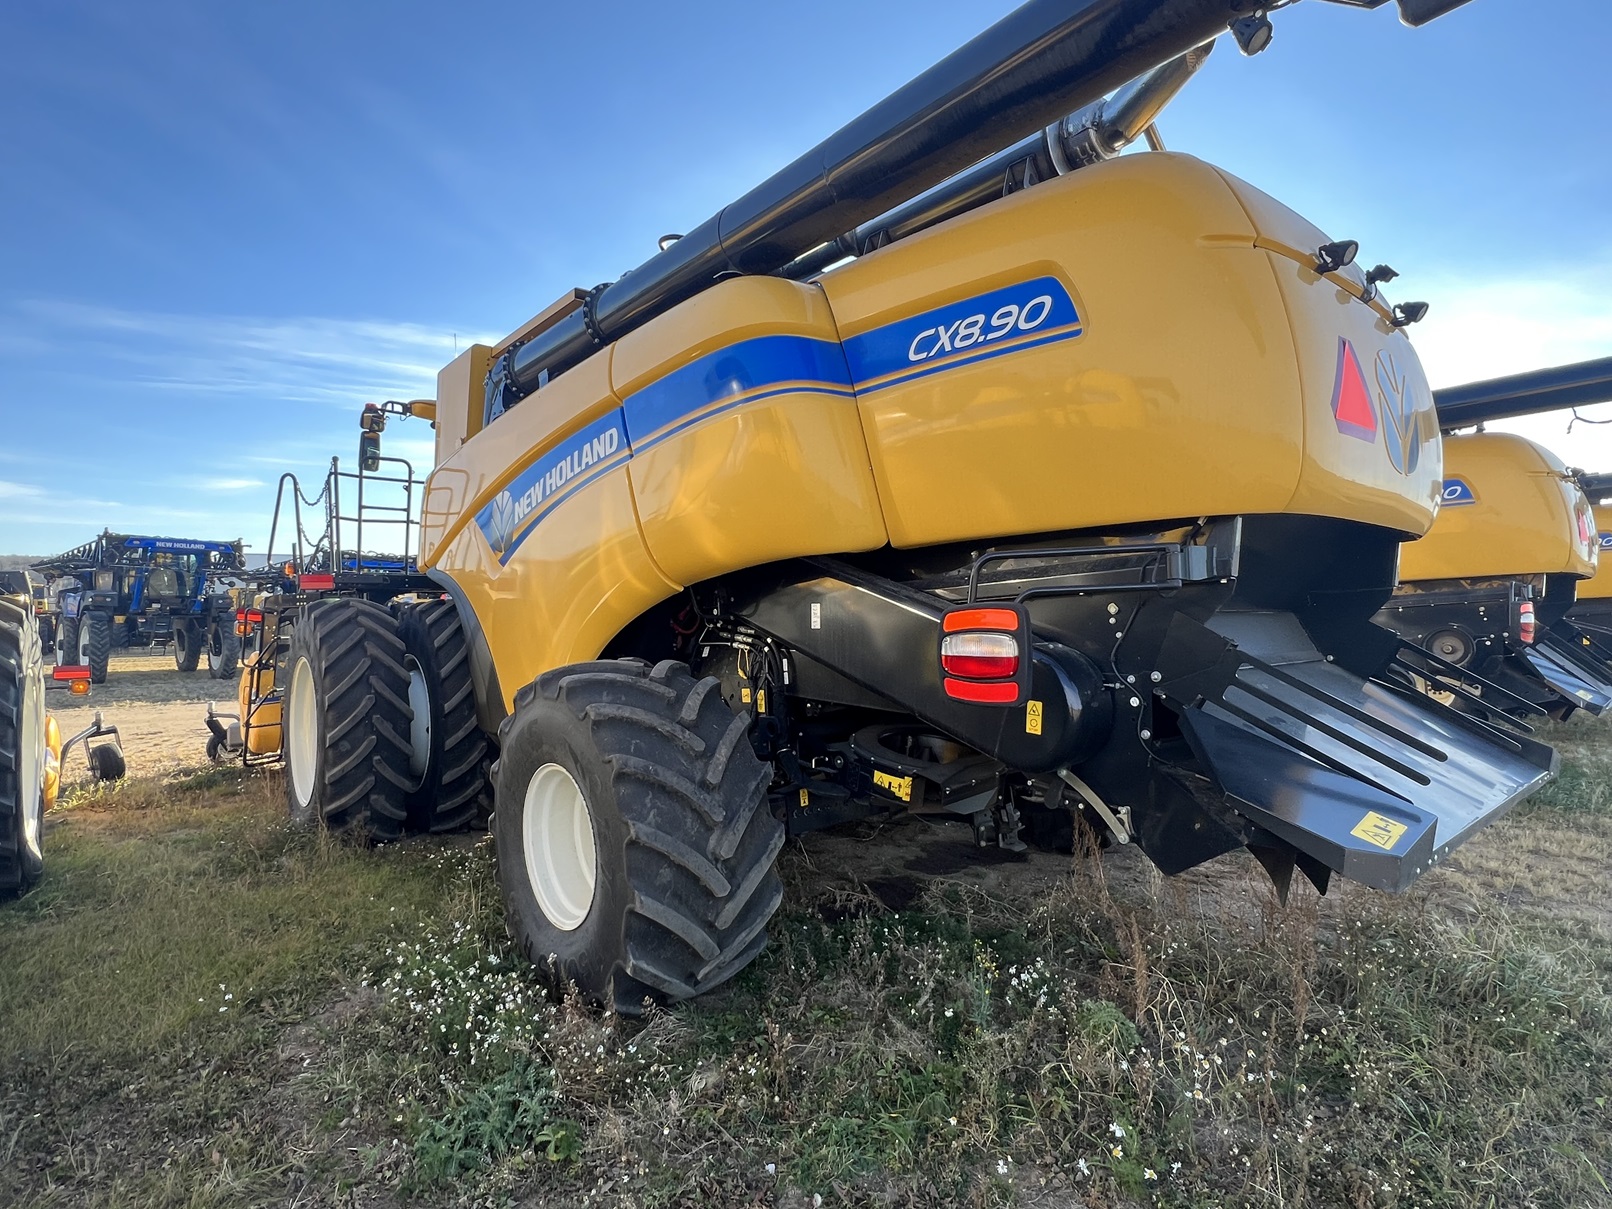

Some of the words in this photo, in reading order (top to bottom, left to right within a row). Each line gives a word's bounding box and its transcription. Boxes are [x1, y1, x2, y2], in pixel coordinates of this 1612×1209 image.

[908, 295, 1053, 362] CX8.90
[514, 478, 544, 524] NEW
[545, 427, 619, 496] HOLLAND
[173, 542, 206, 550] HOLLAND
